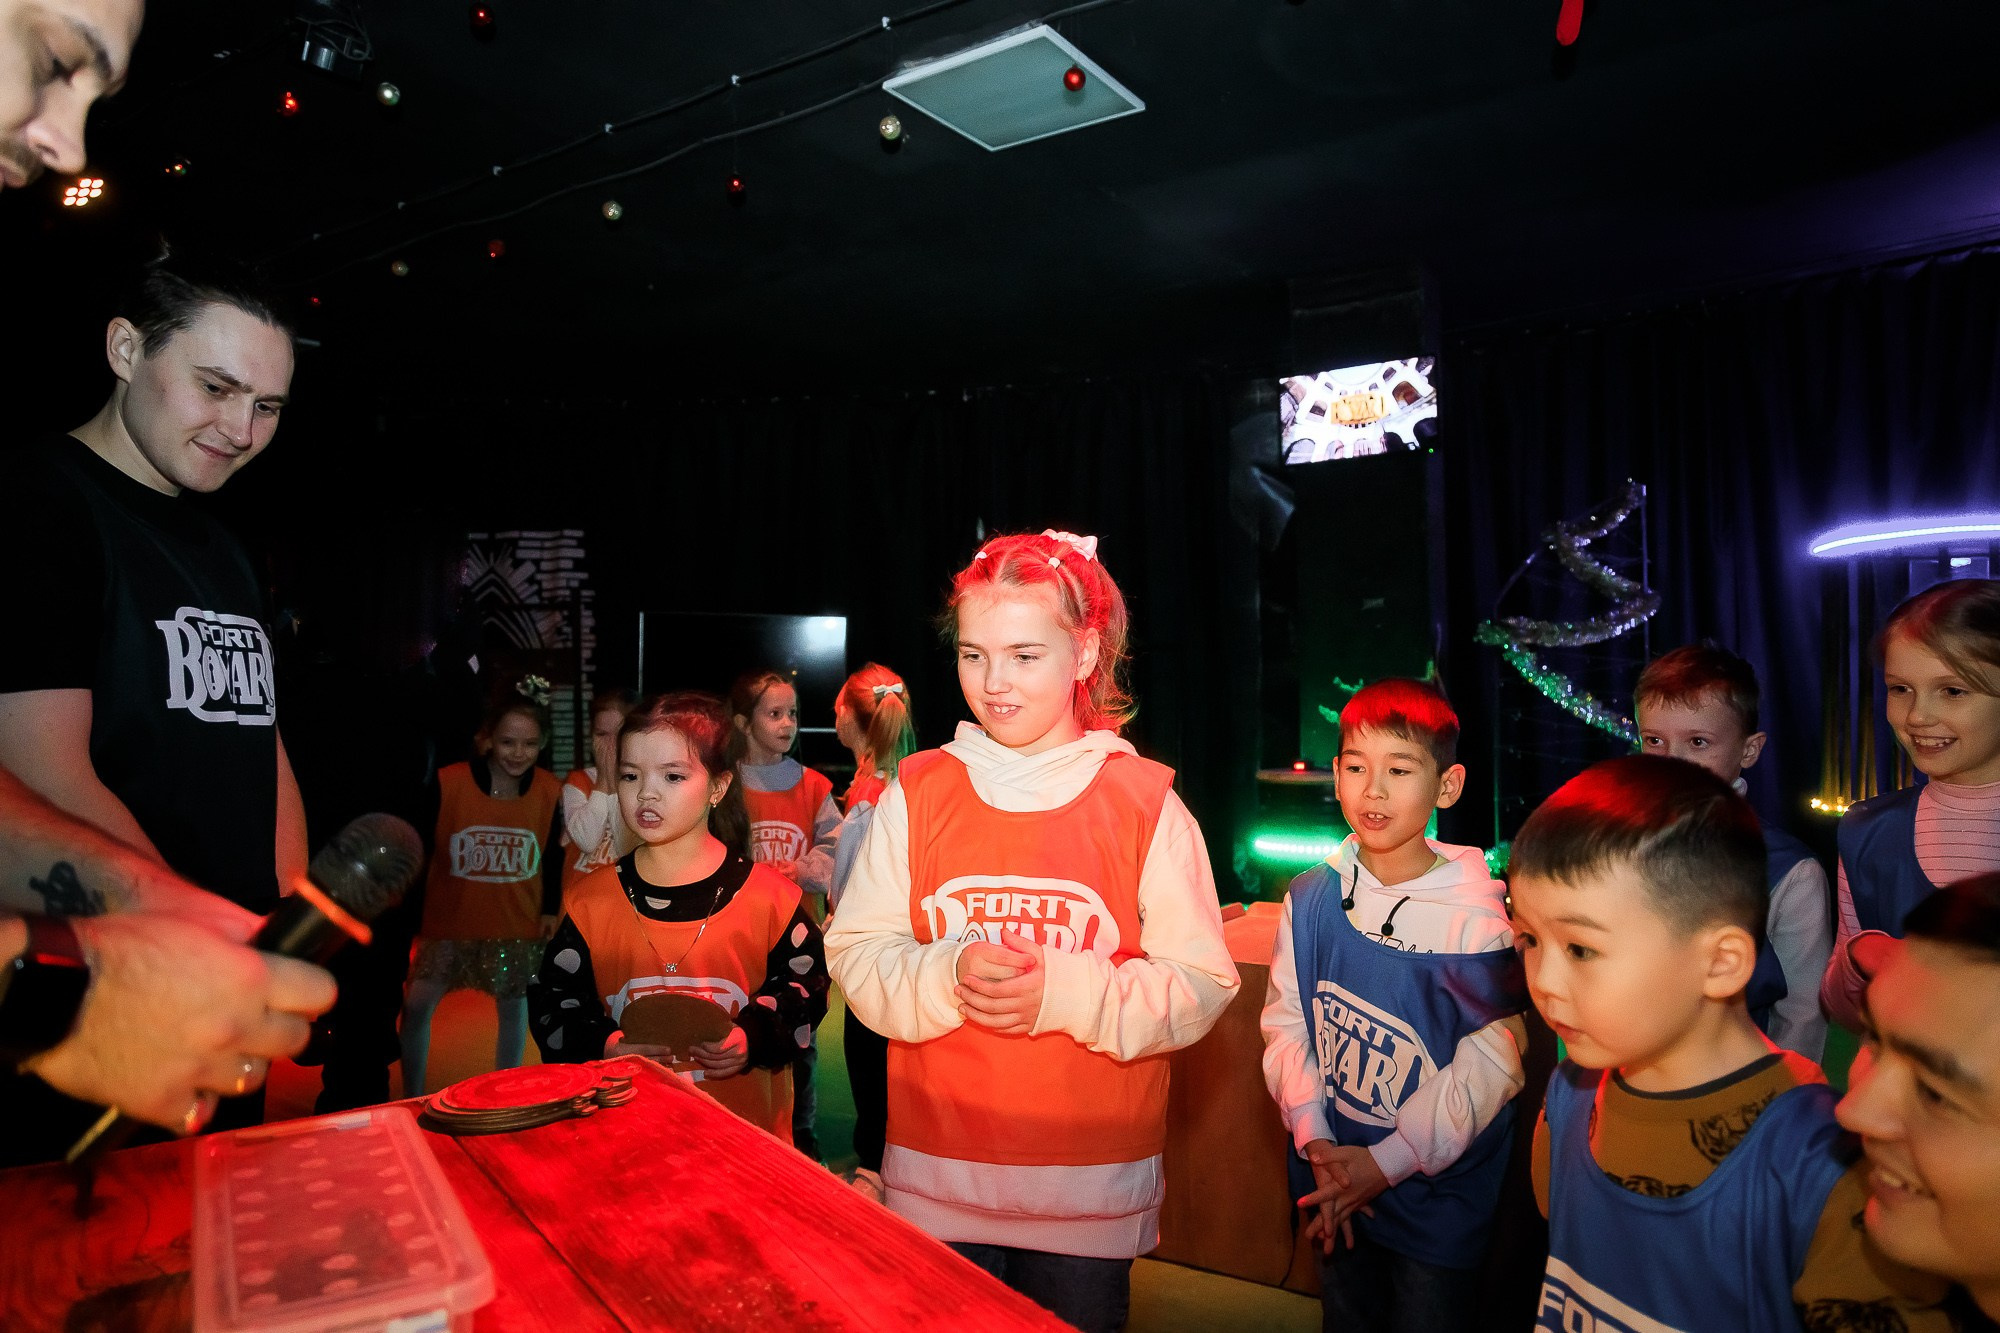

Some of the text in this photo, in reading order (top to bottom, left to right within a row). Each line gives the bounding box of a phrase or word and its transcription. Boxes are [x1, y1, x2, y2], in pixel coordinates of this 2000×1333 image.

[197, 621, 255, 649] FORT
[474, 833, 524, 845] FORT
[449, 825, 542, 883] BOYARD
[966, 892, 1067, 919] FORT
